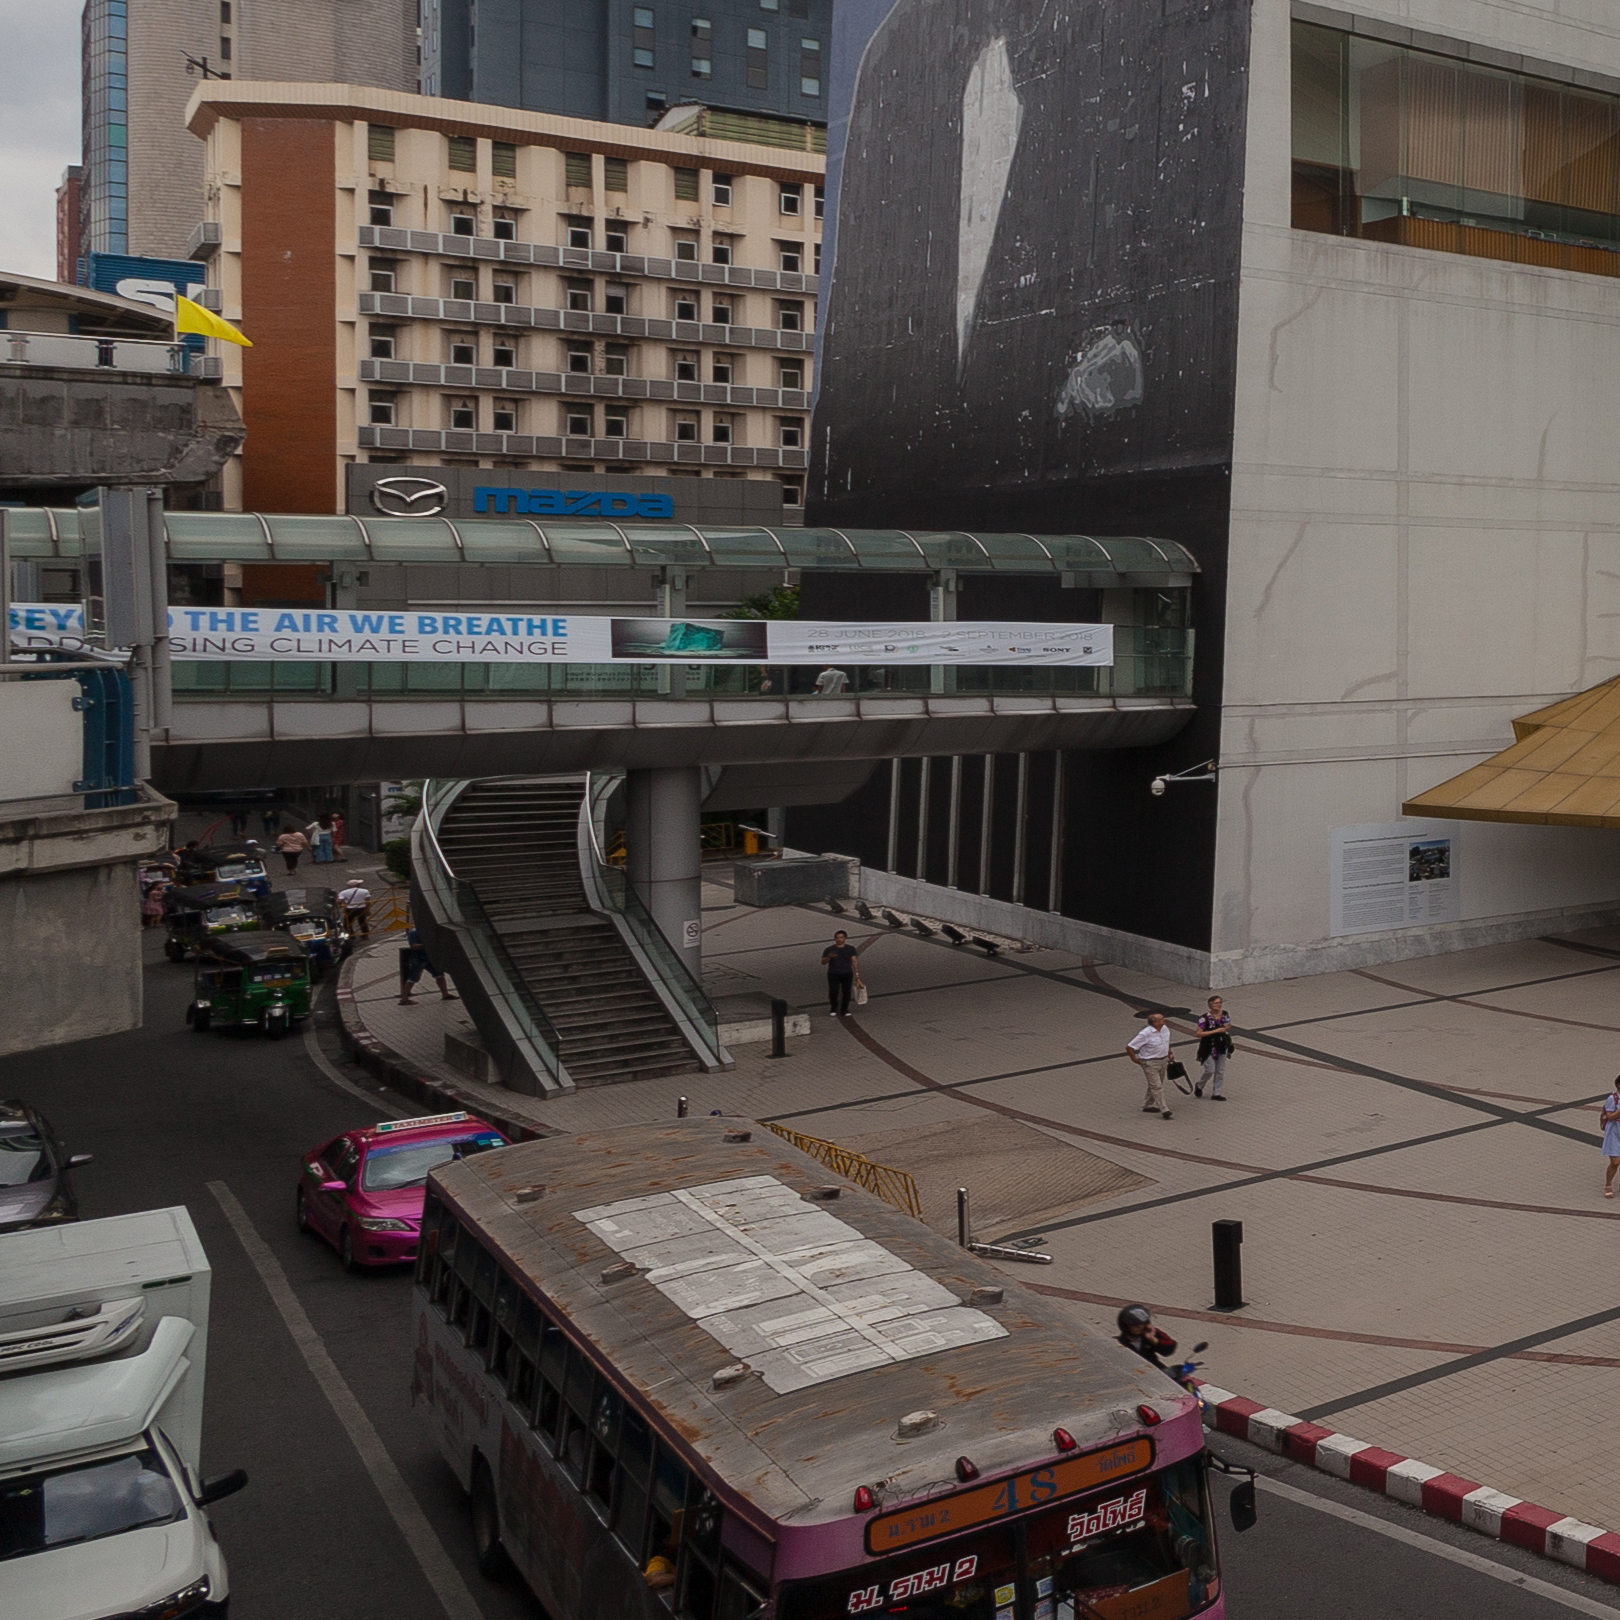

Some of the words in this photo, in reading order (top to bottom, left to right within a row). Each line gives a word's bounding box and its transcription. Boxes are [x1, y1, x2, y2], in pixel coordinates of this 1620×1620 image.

[184, 611, 260, 633] THE
[274, 612, 339, 633] AIR
[348, 614, 406, 635] WE
[418, 615, 568, 638] BREATHE
[807, 629, 829, 638] 28
[834, 629, 883, 639] JUNE
[957, 630, 1055, 640] SEPTEMBER
[269, 638, 420, 654] CLIMATE
[432, 639, 569, 656] CHANGE
[992, 1468, 1058, 1512] 48
[939, 1509, 951, 1523] 2
[889, 1563, 950, 1600] ราม
[952, 1555, 978, 1582] 2
